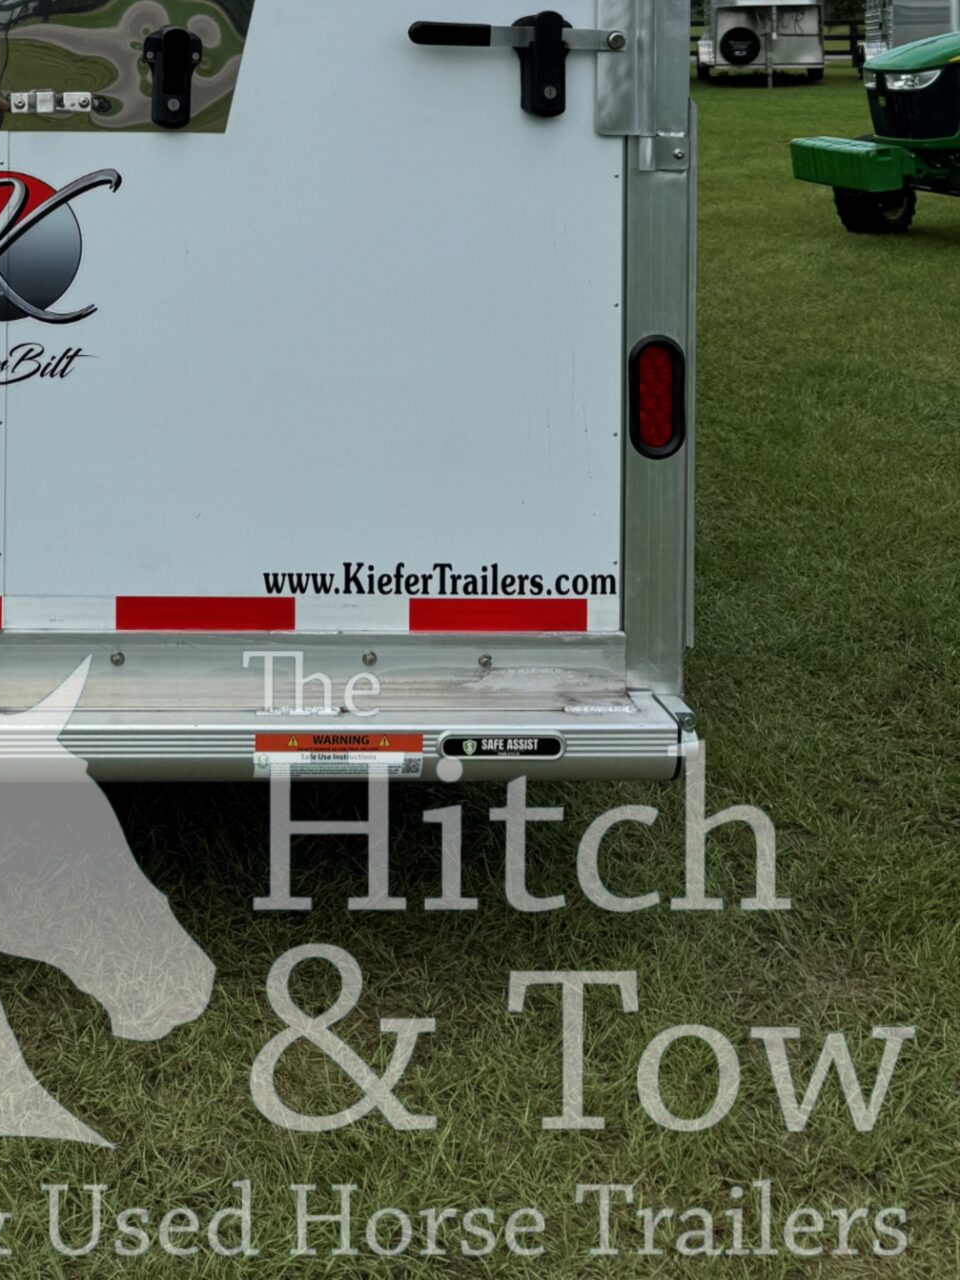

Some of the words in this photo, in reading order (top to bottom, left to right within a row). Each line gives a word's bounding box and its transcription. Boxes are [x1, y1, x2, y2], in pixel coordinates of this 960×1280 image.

[262, 562, 617, 596] www.KieferTrailers.com
[313, 735, 370, 745] WARNING
[481, 738, 504, 750] SAFE
[506, 738, 539, 750] ASSIST
[300, 752, 316, 761] Safe
[317, 752, 332, 761] Use
[333, 752, 377, 761] Instructions
